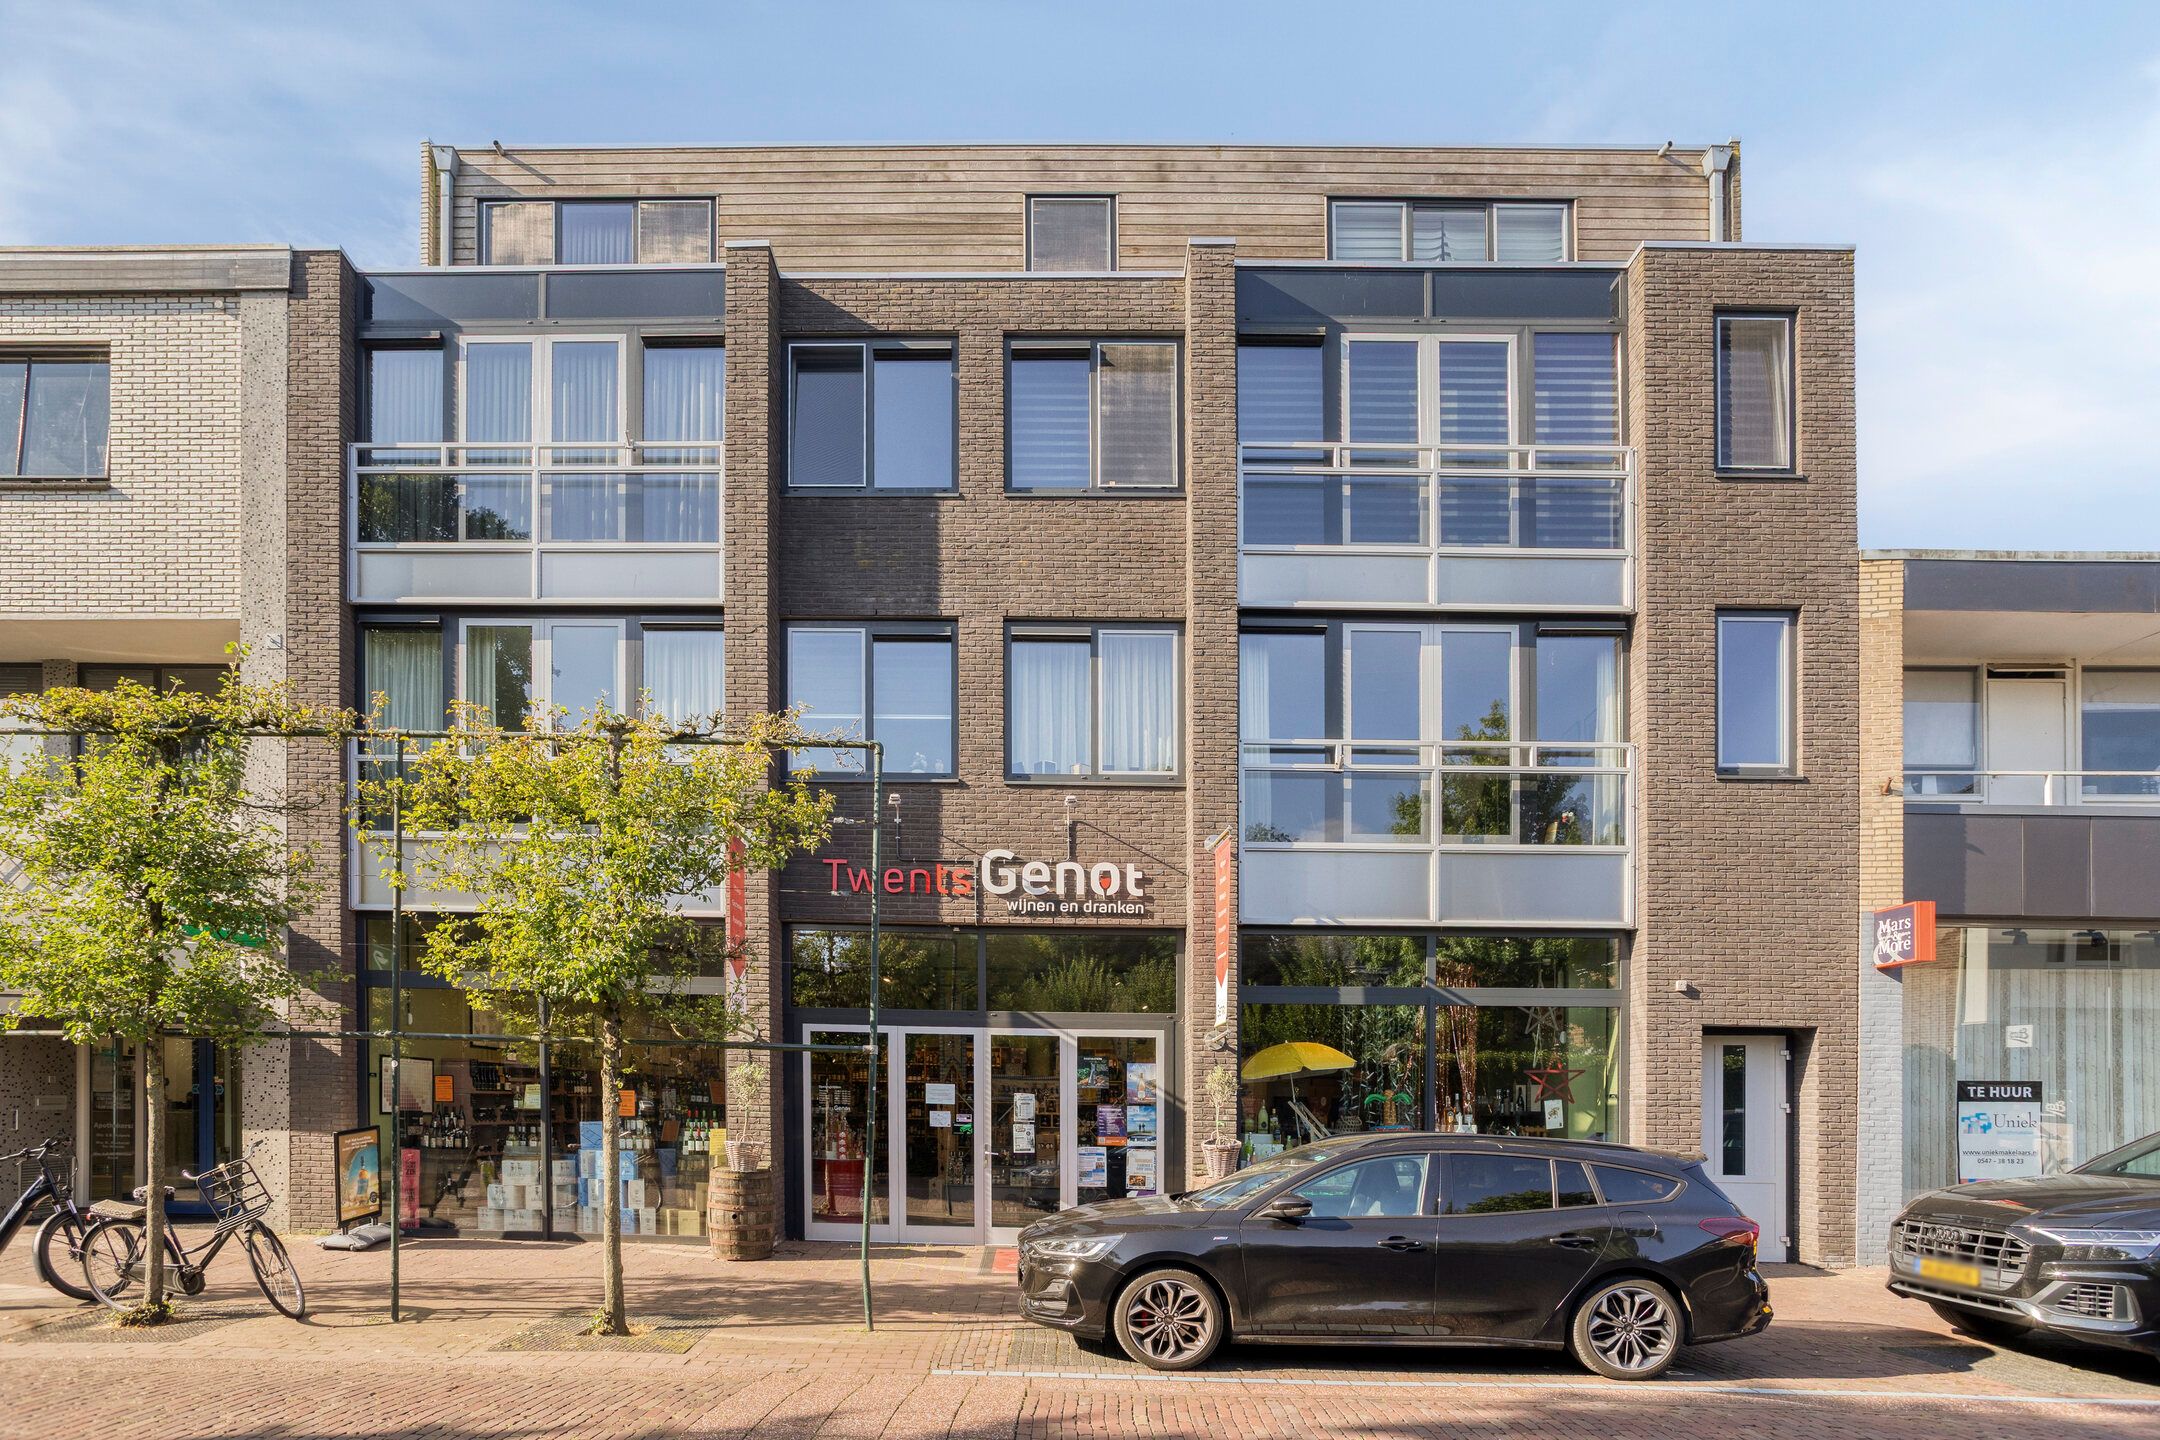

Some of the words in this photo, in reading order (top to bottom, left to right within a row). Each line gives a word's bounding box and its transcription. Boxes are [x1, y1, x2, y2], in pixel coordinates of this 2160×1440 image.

[1007, 899, 1055, 914] wijnen
[1060, 902, 1079, 912] en
[1083, 900, 1144, 914] dranken
[1879, 917, 1911, 933] Mars
[1878, 938, 1911, 954] More
[1967, 1086, 1985, 1098] TE
[1989, 1086, 2032, 1098] HUUR
[1993, 1112, 2037, 1128] Uniek
